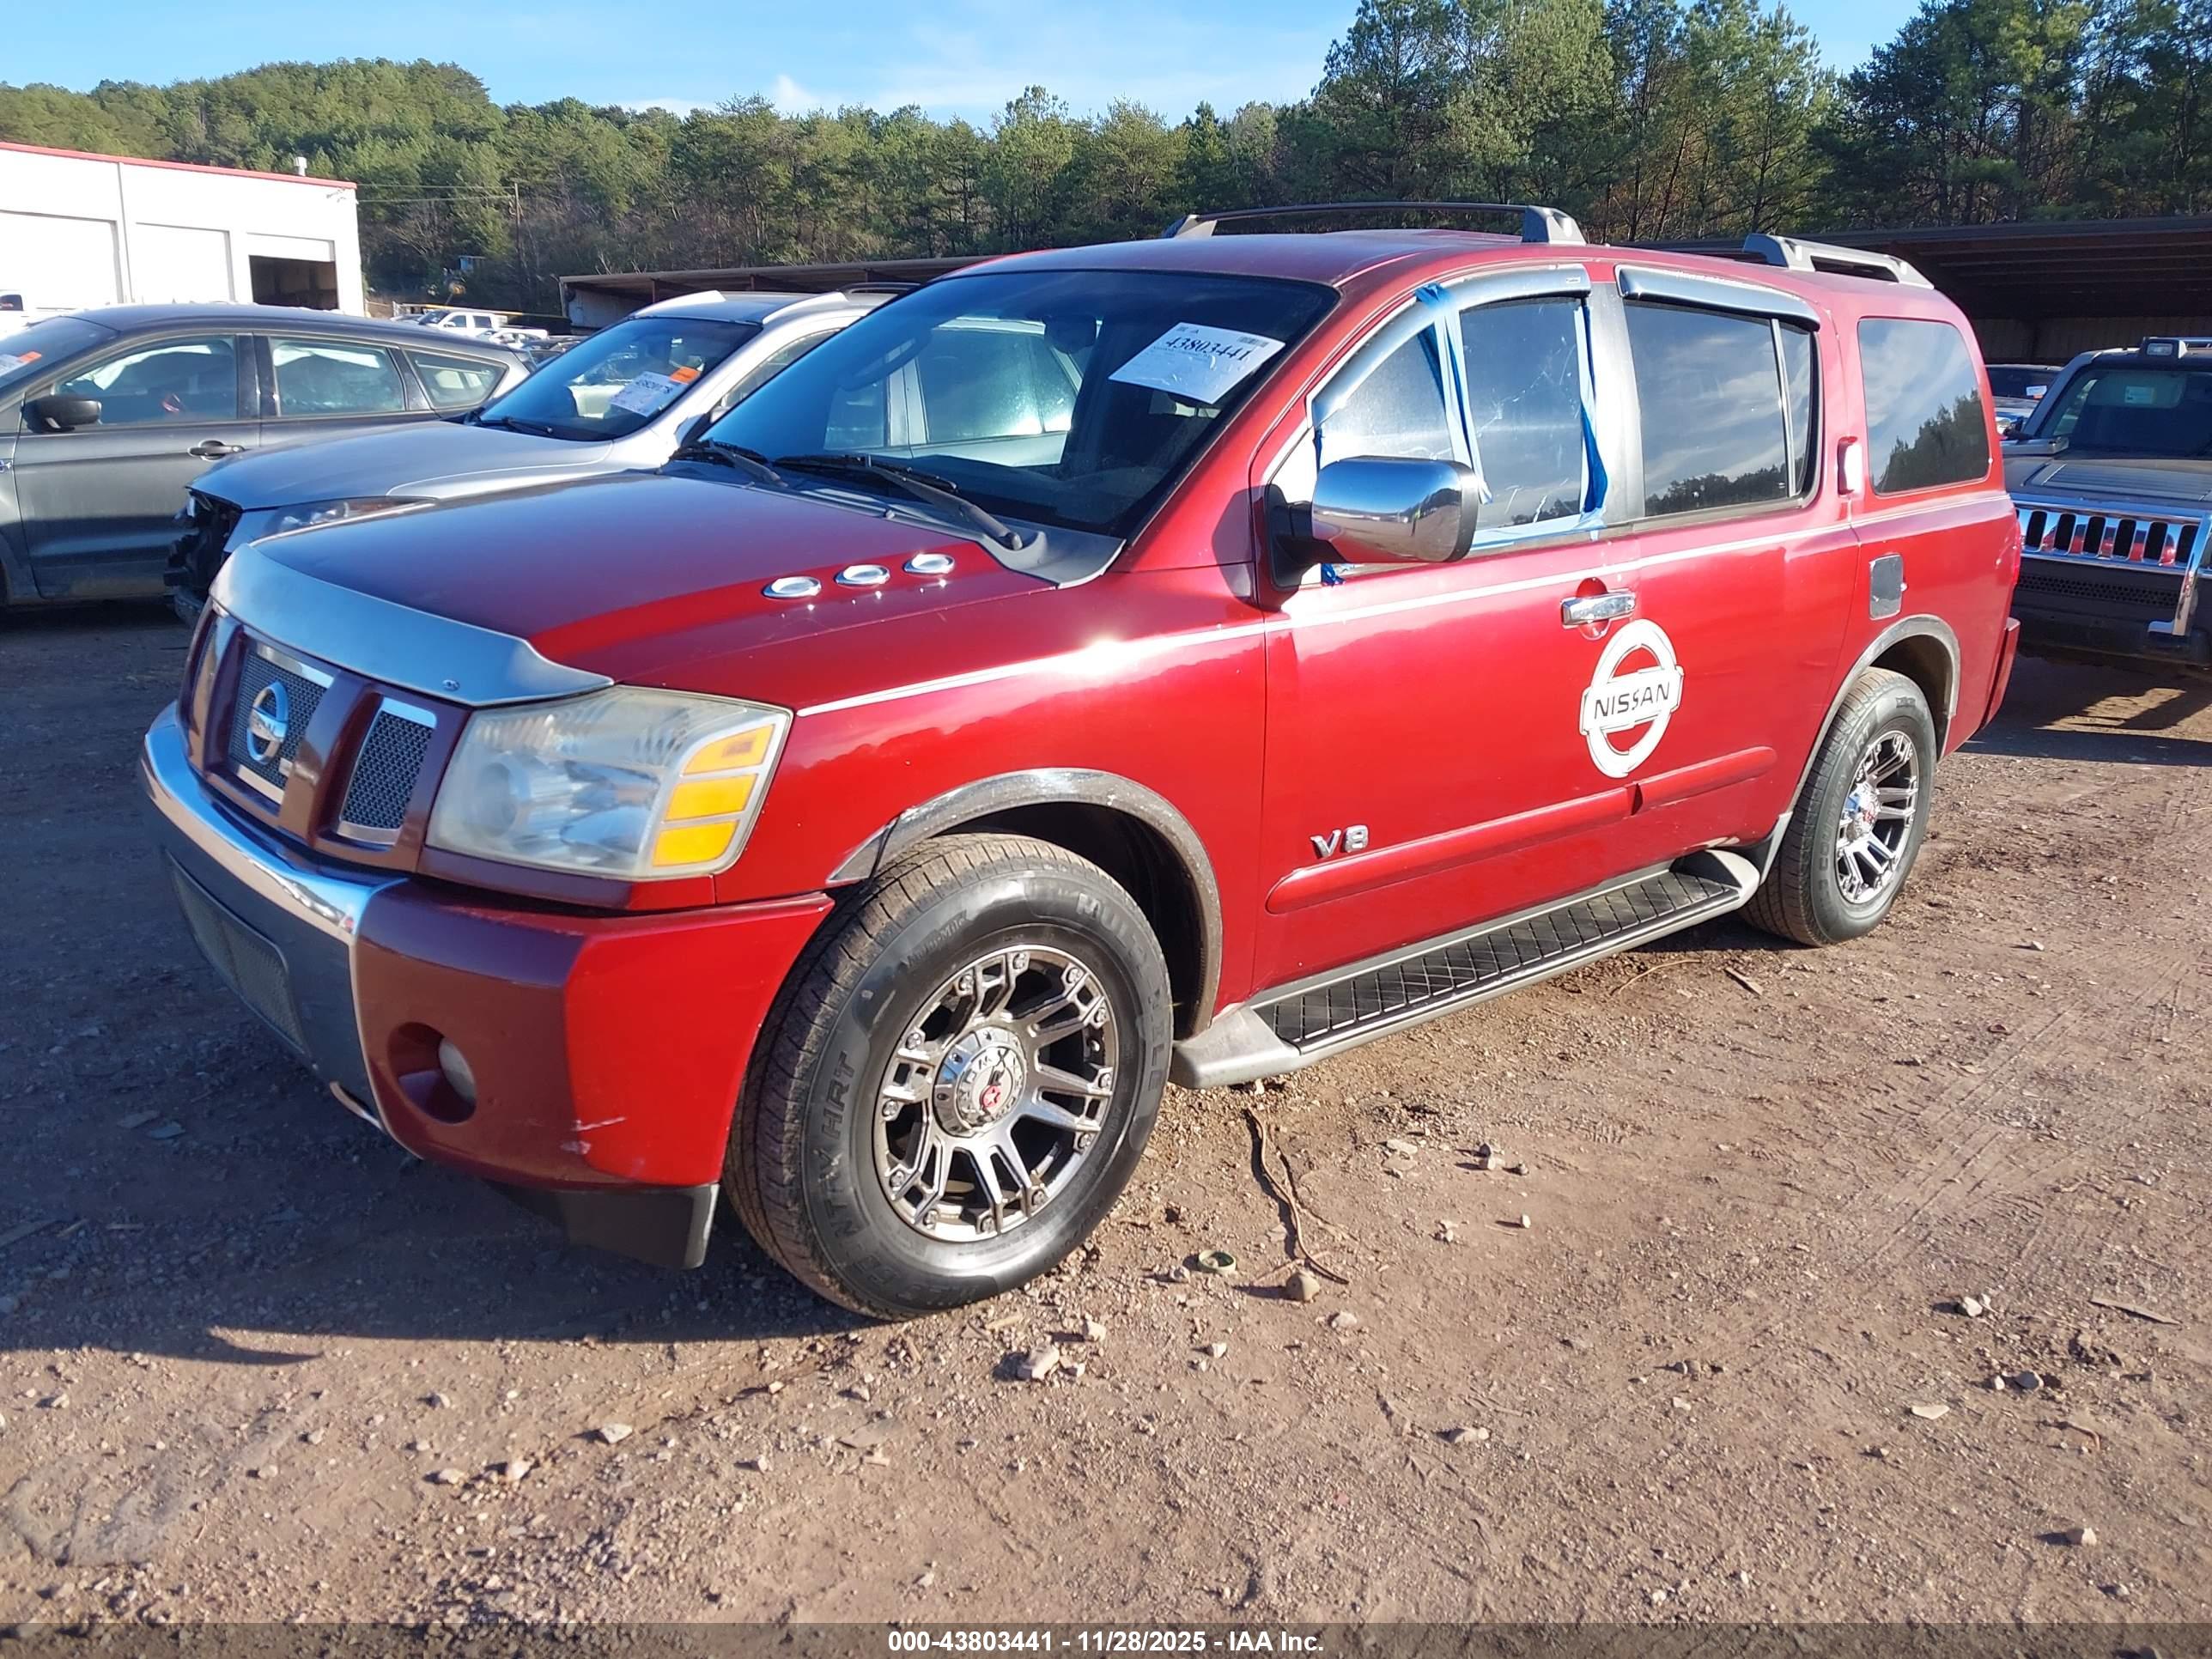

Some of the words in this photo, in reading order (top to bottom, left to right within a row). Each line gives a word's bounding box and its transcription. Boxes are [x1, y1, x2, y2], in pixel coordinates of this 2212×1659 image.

[1166, 336, 1252, 361] 43803441
[1594, 681, 1670, 720] NISSAN
[1310, 824, 1369, 859] V8
[821, 1050, 855, 1140] HRT
